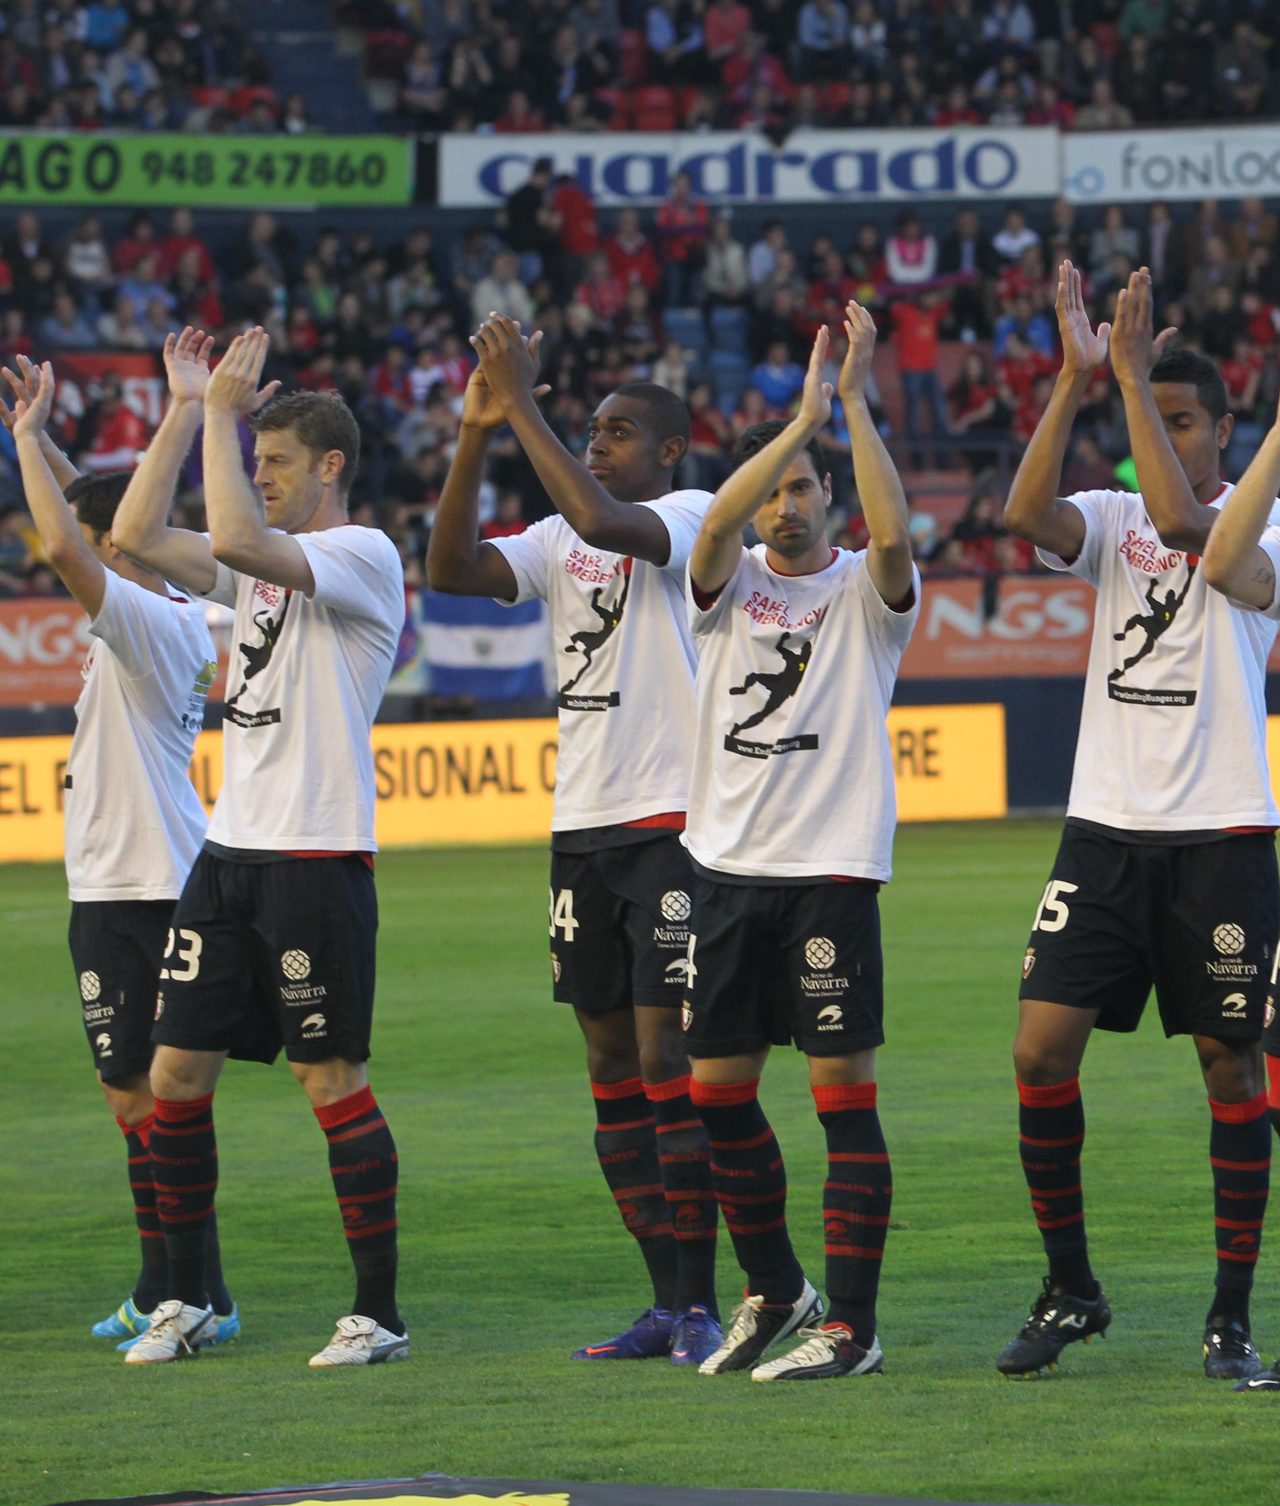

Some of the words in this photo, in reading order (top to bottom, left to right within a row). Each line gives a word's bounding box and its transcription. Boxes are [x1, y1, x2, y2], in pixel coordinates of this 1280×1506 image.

[0, 140, 124, 193] AGO
[141, 151, 216, 187] 948
[228, 152, 388, 189] 247860
[925, 588, 1091, 641] NGS
[374, 744, 527, 800] SIONAL
[653, 926, 691, 942] Navar
[1205, 961, 1258, 975] Navarra
[800, 975, 850, 990] Navarra
[280, 985, 327, 1000] Navarra
